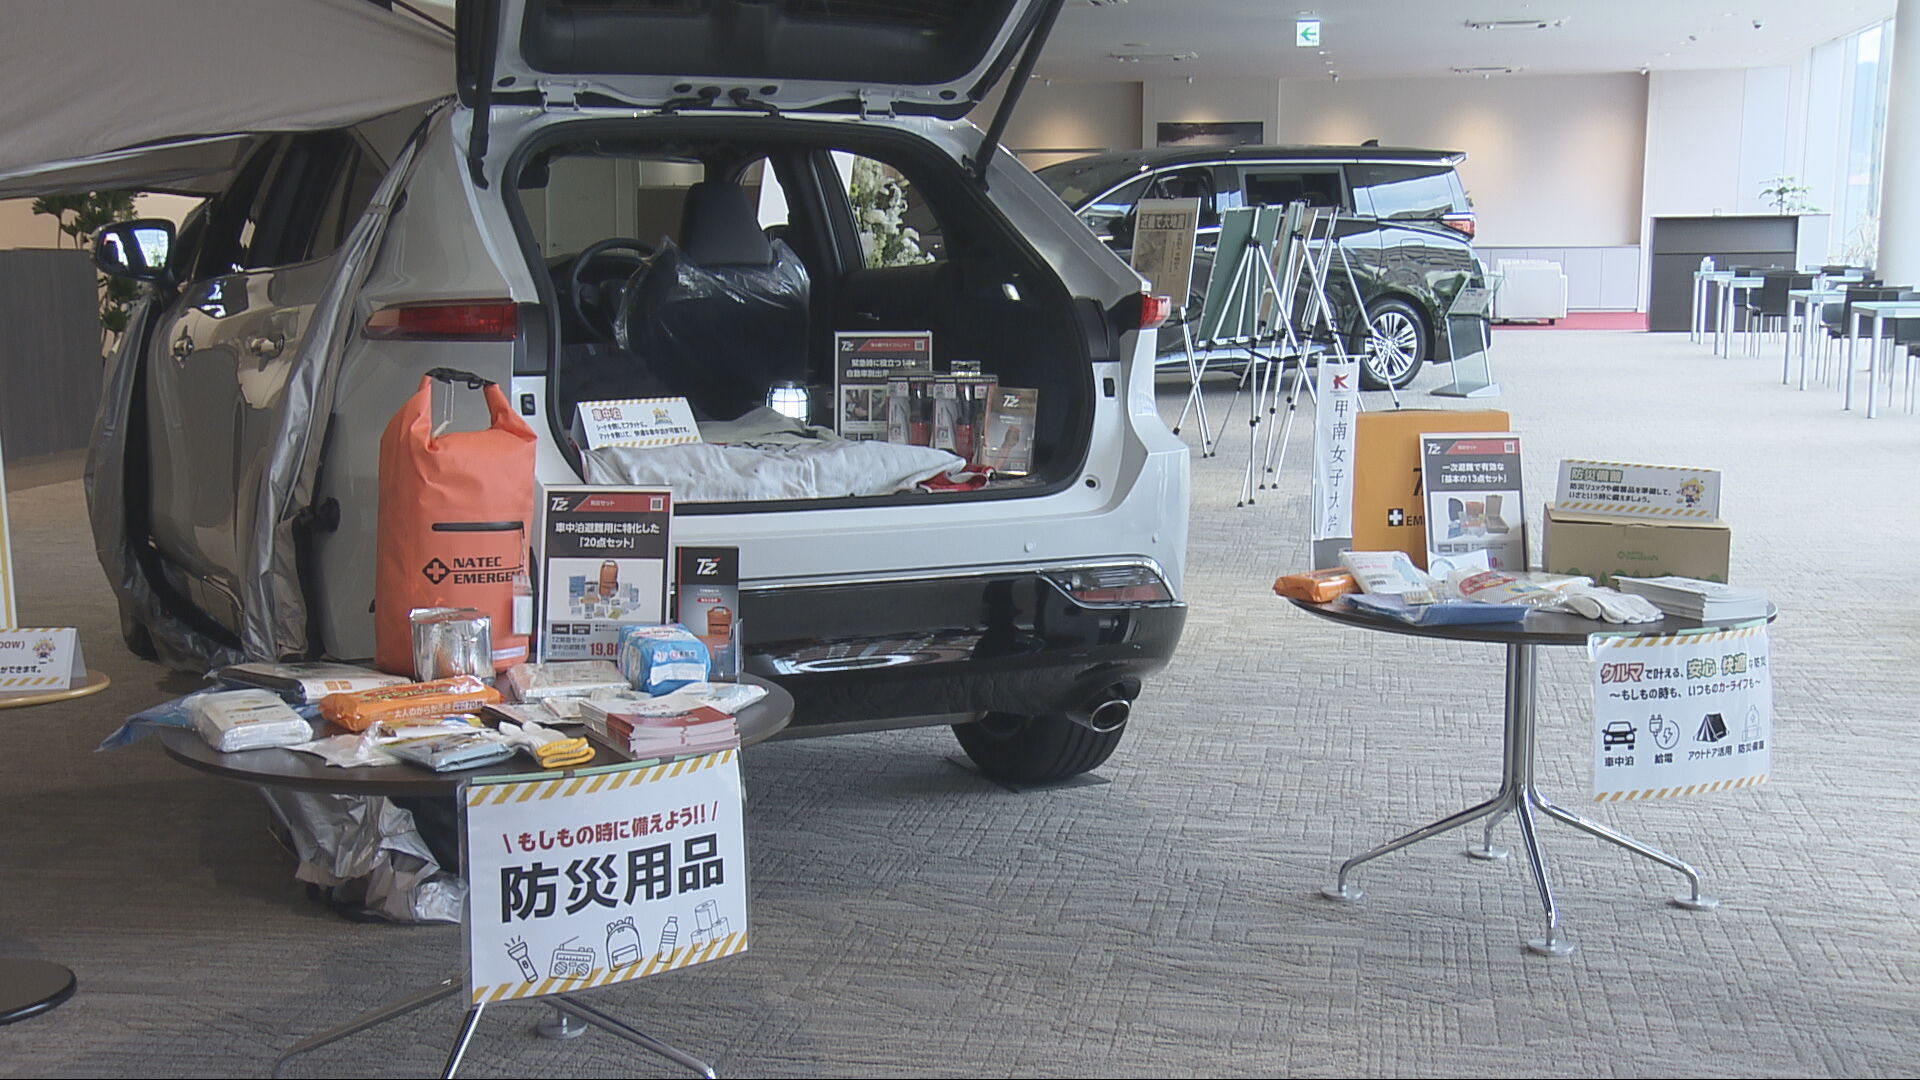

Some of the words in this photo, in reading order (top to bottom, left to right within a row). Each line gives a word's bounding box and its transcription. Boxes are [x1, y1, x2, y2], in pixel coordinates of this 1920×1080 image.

[555, 522, 660, 534] 車中泊避難用に特化した
[579, 537, 635, 548] 「20点セット」
[453, 557, 502, 568] NATEC
[1604, 755, 1634, 767] 車中泊
[1654, 752, 1673, 764] 給電
[500, 832, 725, 924] 防災用品
